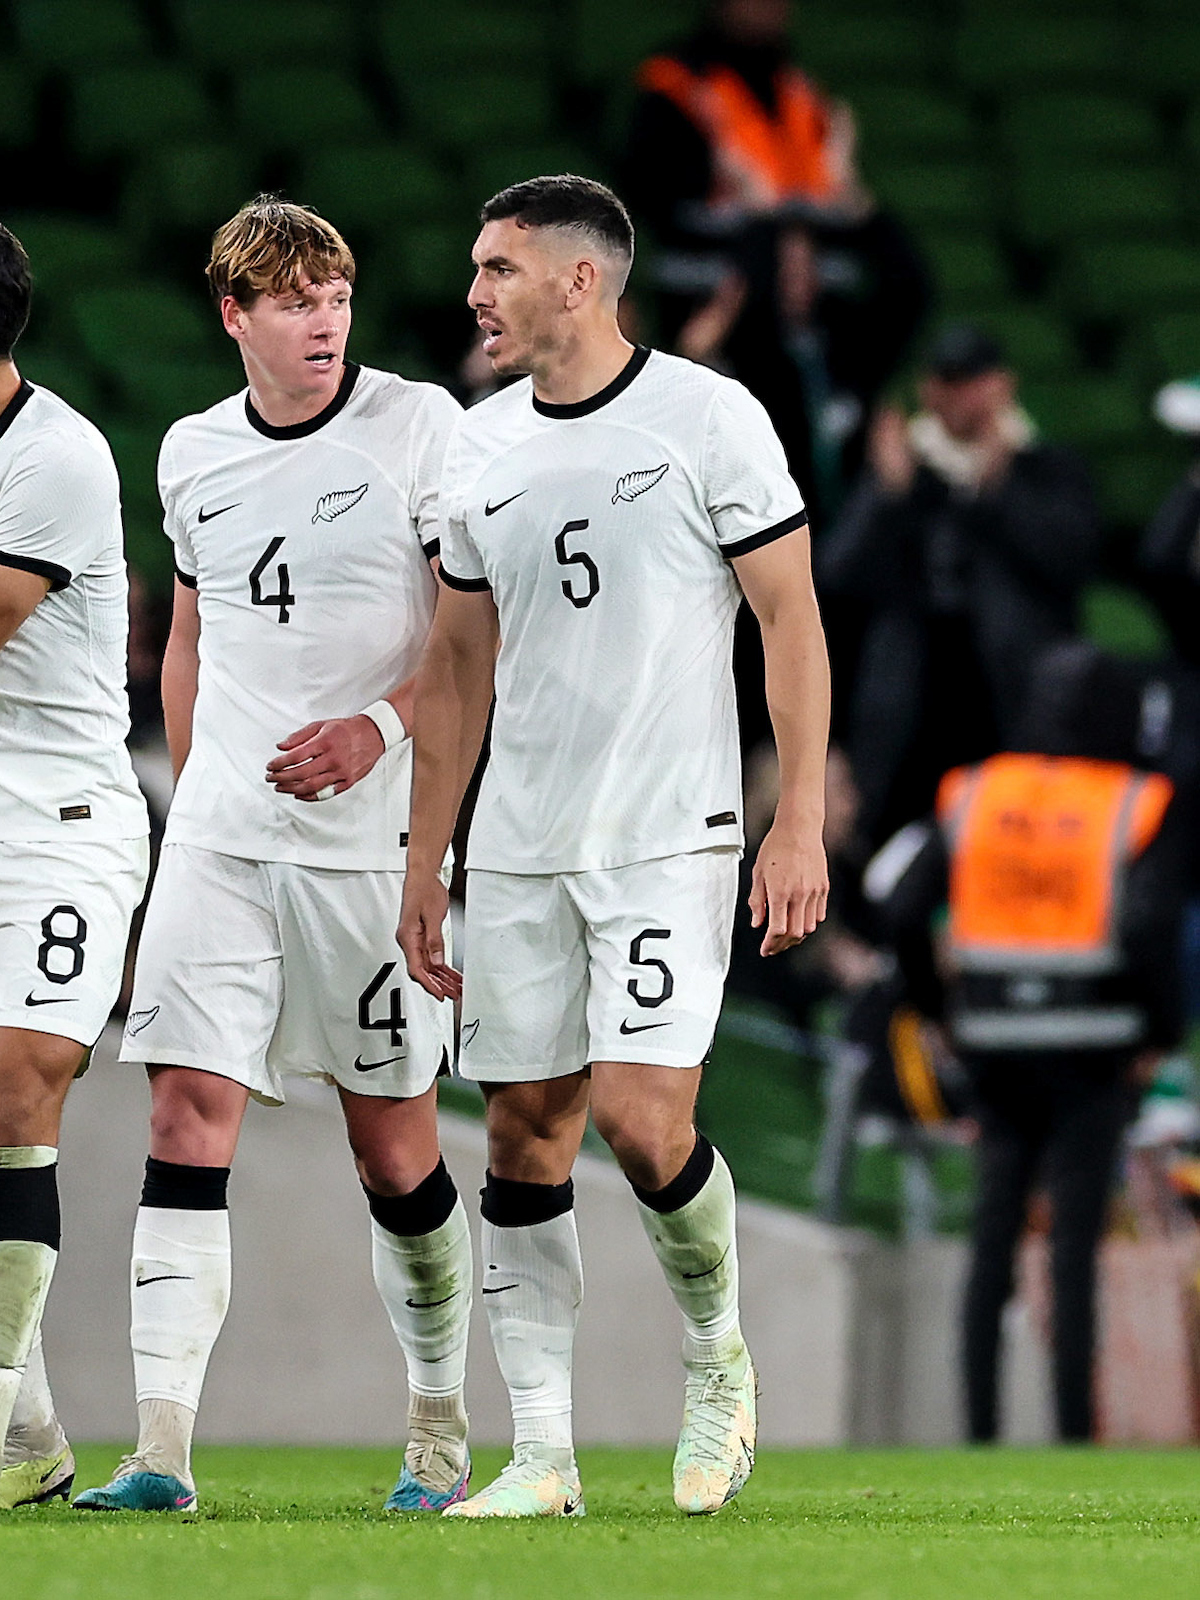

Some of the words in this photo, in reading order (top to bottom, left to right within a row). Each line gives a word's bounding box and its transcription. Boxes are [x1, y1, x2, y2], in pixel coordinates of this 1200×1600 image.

[249, 537, 296, 624] 4
[555, 519, 600, 608] 5
[37, 905, 87, 985] 8
[627, 929, 674, 1009] 5
[358, 962, 408, 1048] 4
